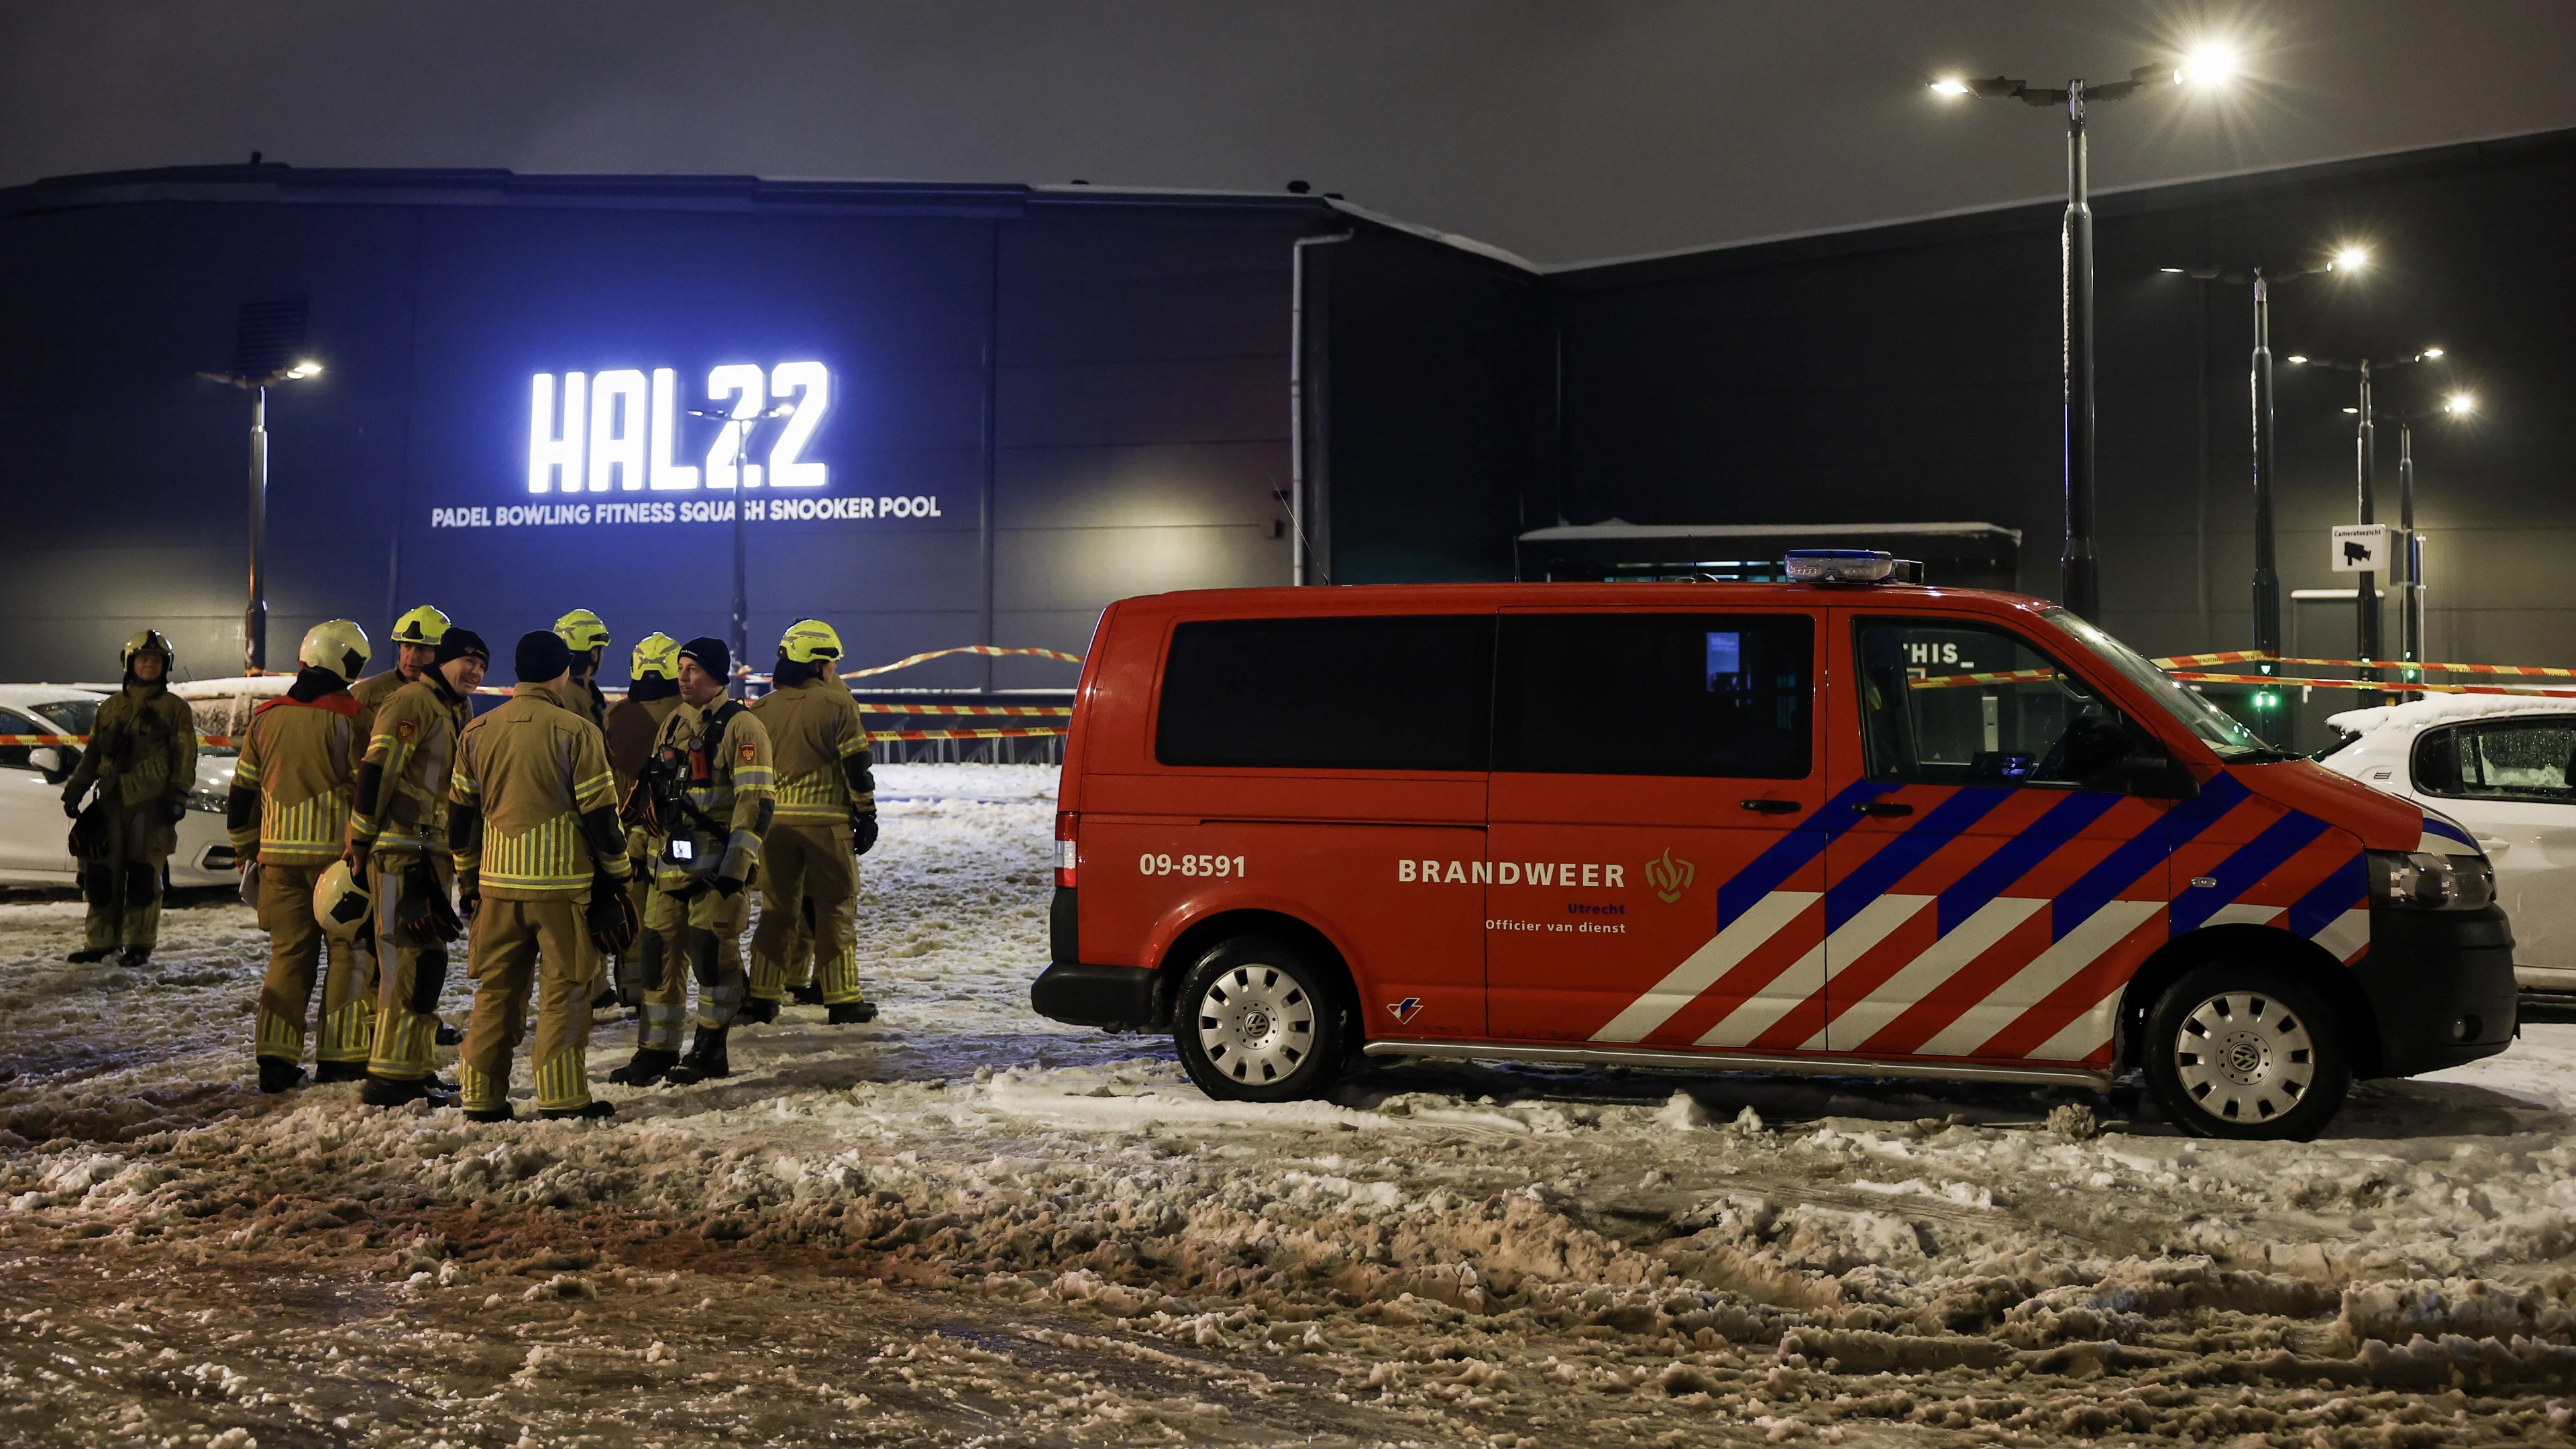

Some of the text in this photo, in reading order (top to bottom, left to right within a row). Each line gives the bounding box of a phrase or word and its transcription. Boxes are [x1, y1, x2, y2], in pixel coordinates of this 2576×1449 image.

[528, 361, 828, 494] HAL22
[431, 507, 492, 527] PADEL
[495, 503, 591, 527] BOWLING
[595, 501, 676, 525] FITNESS
[769, 496, 875, 521] SNOOKER
[879, 495, 942, 519] POOL
[1902, 643, 1975, 668] HIS_
[1140, 853, 1245, 877] 09-8591
[1398, 859, 1625, 888] BRANDWEER
[1567, 902, 1625, 915] Utrecht
[1485, 918, 1626, 933] Officier van dienst
